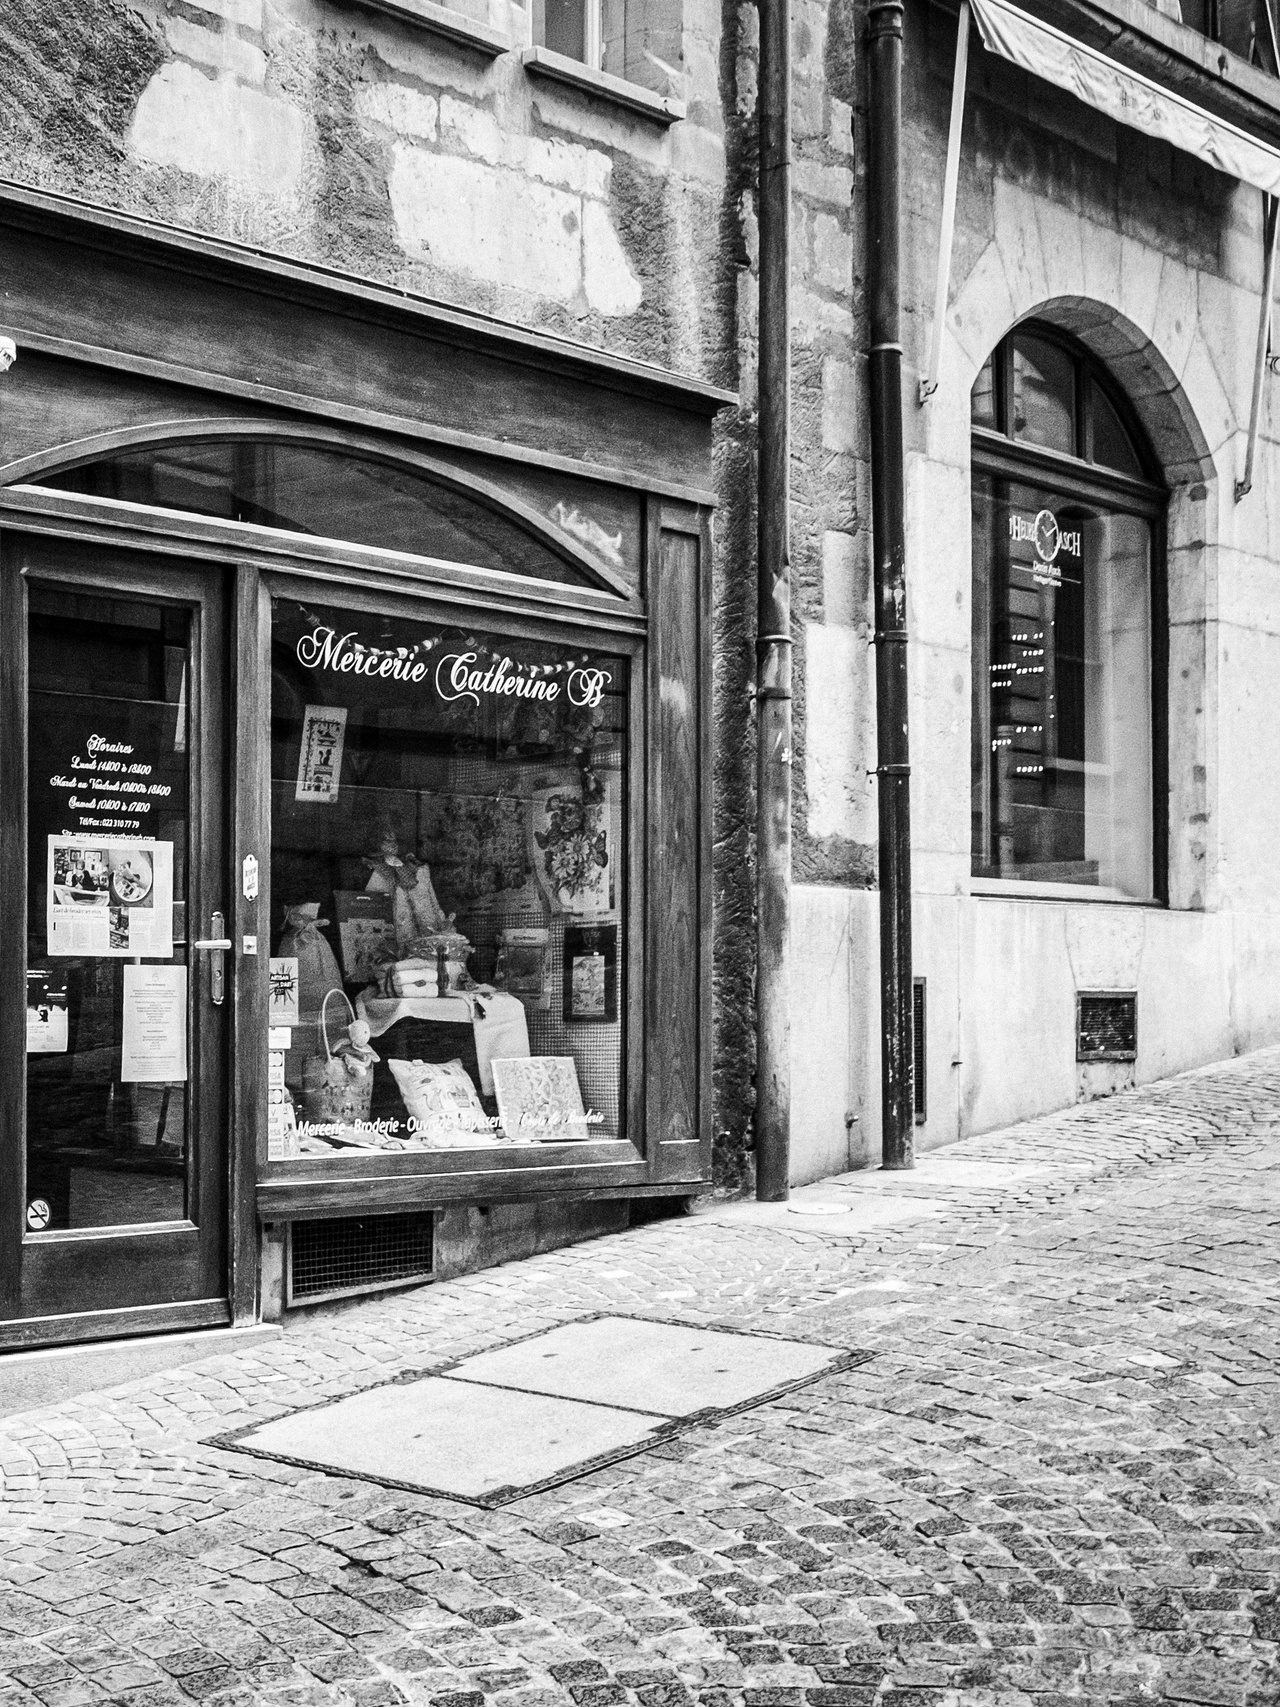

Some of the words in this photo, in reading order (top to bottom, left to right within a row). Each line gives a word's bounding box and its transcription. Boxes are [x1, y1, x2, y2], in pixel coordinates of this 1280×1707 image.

[296, 626, 428, 682] Mercerie
[435, 652, 561, 706] Catherine
[567, 668, 612, 707] B
[86, 733, 134, 758] Horaires
[71, 755, 97, 770] Lundi
[113, 819, 124, 828] 310
[124, 820, 132, 828] 77
[132, 820, 140, 829] 79
[298, 1119, 346, 1136] Mercerie
[353, 1117, 399, 1133] Broderie
